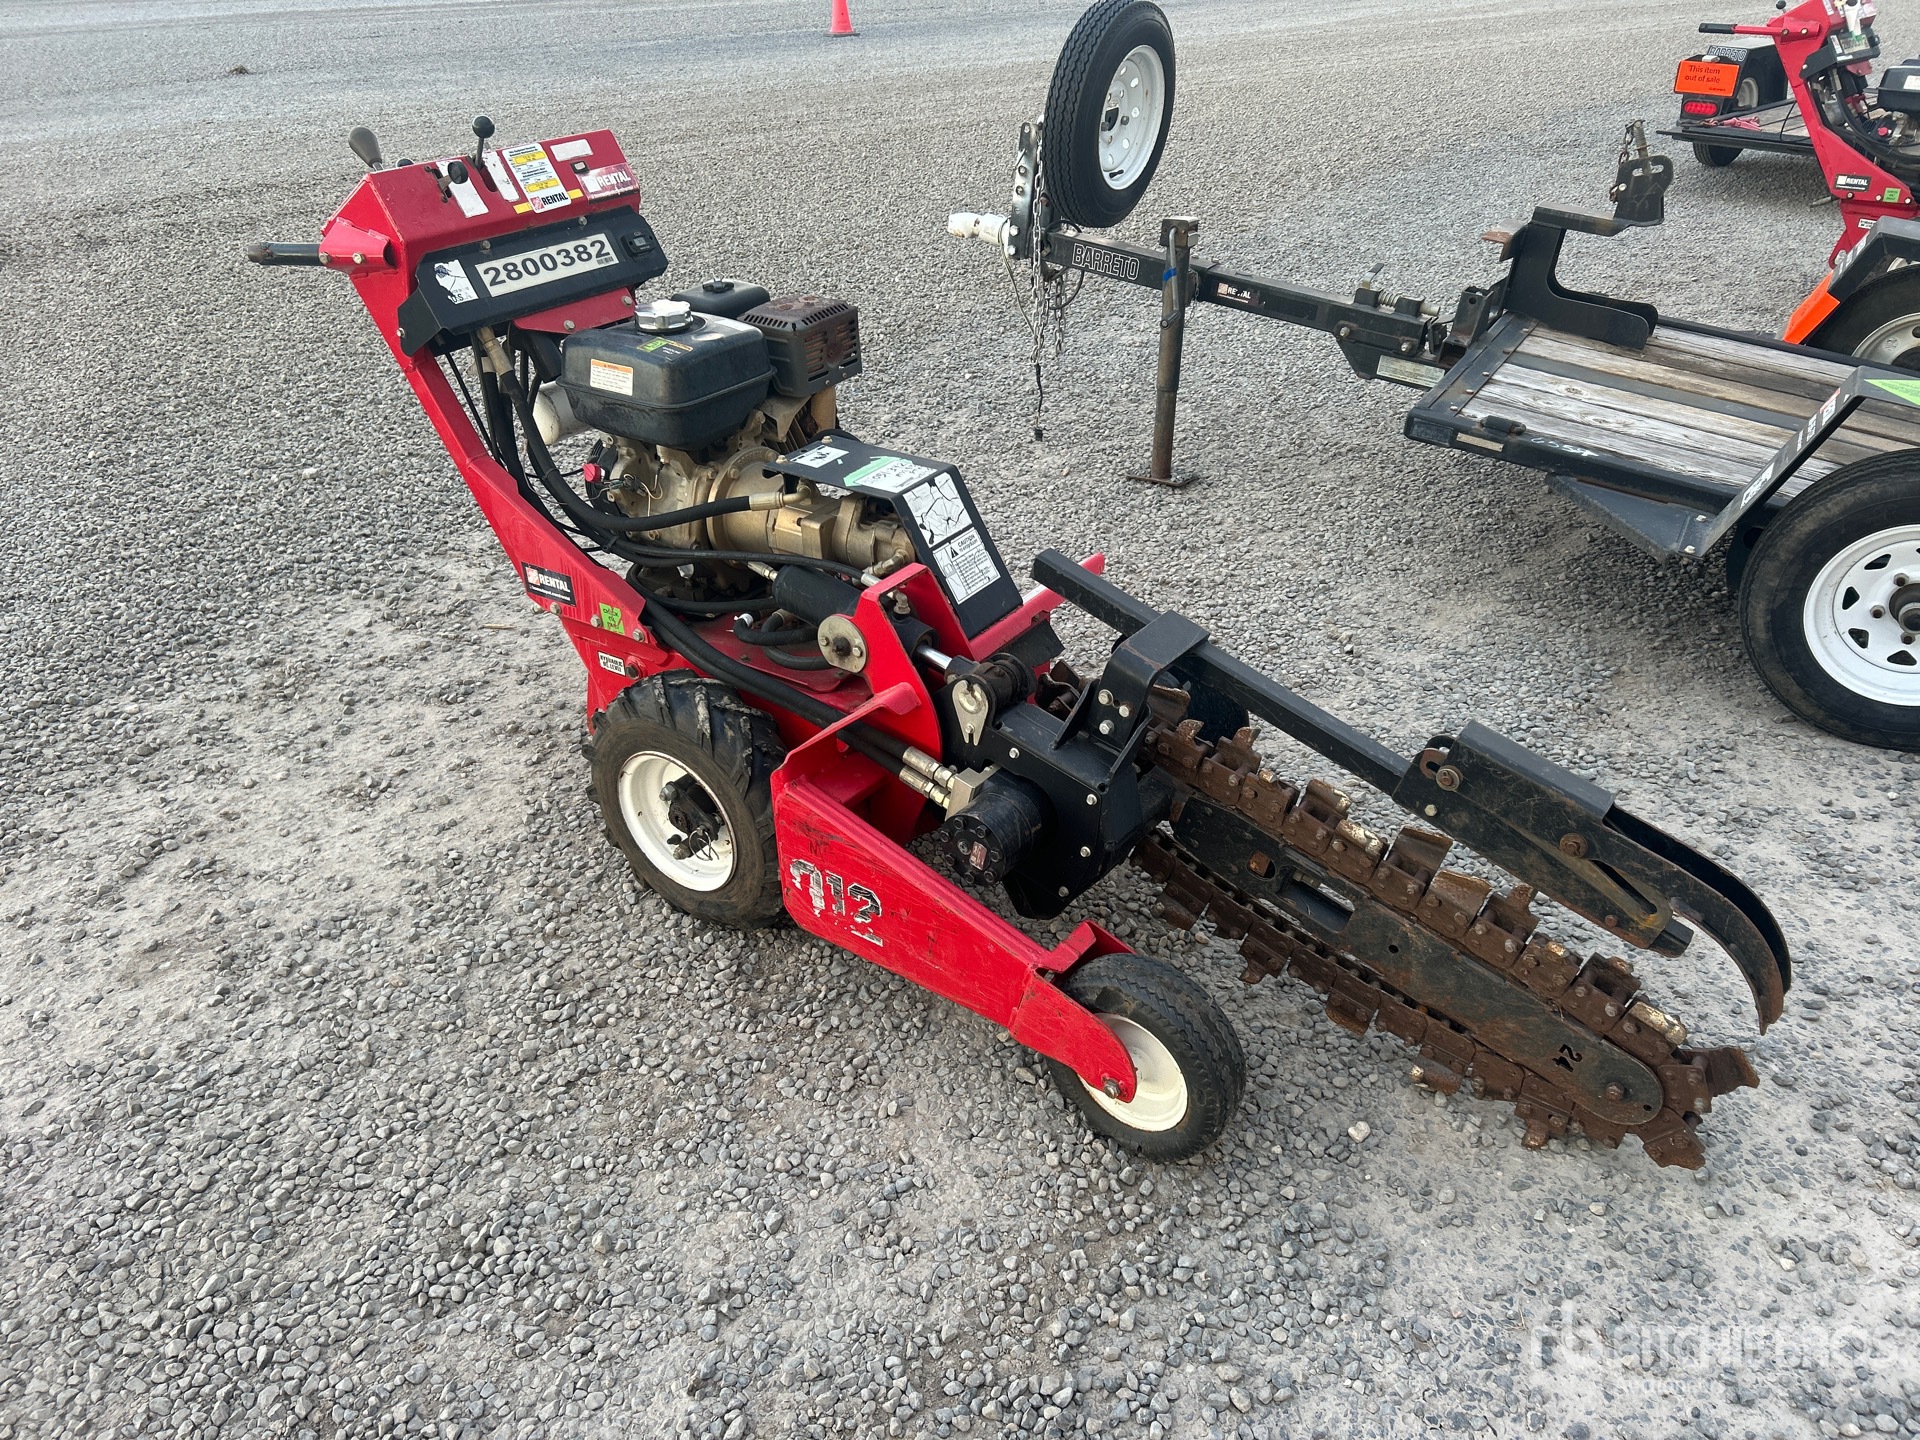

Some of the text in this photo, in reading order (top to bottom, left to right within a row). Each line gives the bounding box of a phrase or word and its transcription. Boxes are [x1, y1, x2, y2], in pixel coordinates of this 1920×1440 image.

[1688, 64, 1721, 75] This item
[1684, 74, 1721, 84] out of sale
[598, 170, 632, 188] RENTAL
[1845, 176, 1869, 186] RENTAL
[541, 191, 569, 206] RENTAL
[483, 239, 611, 287] 2800382
[1071, 242, 1140, 281] BARRETO
[538, 573, 571, 593] RENTAL
